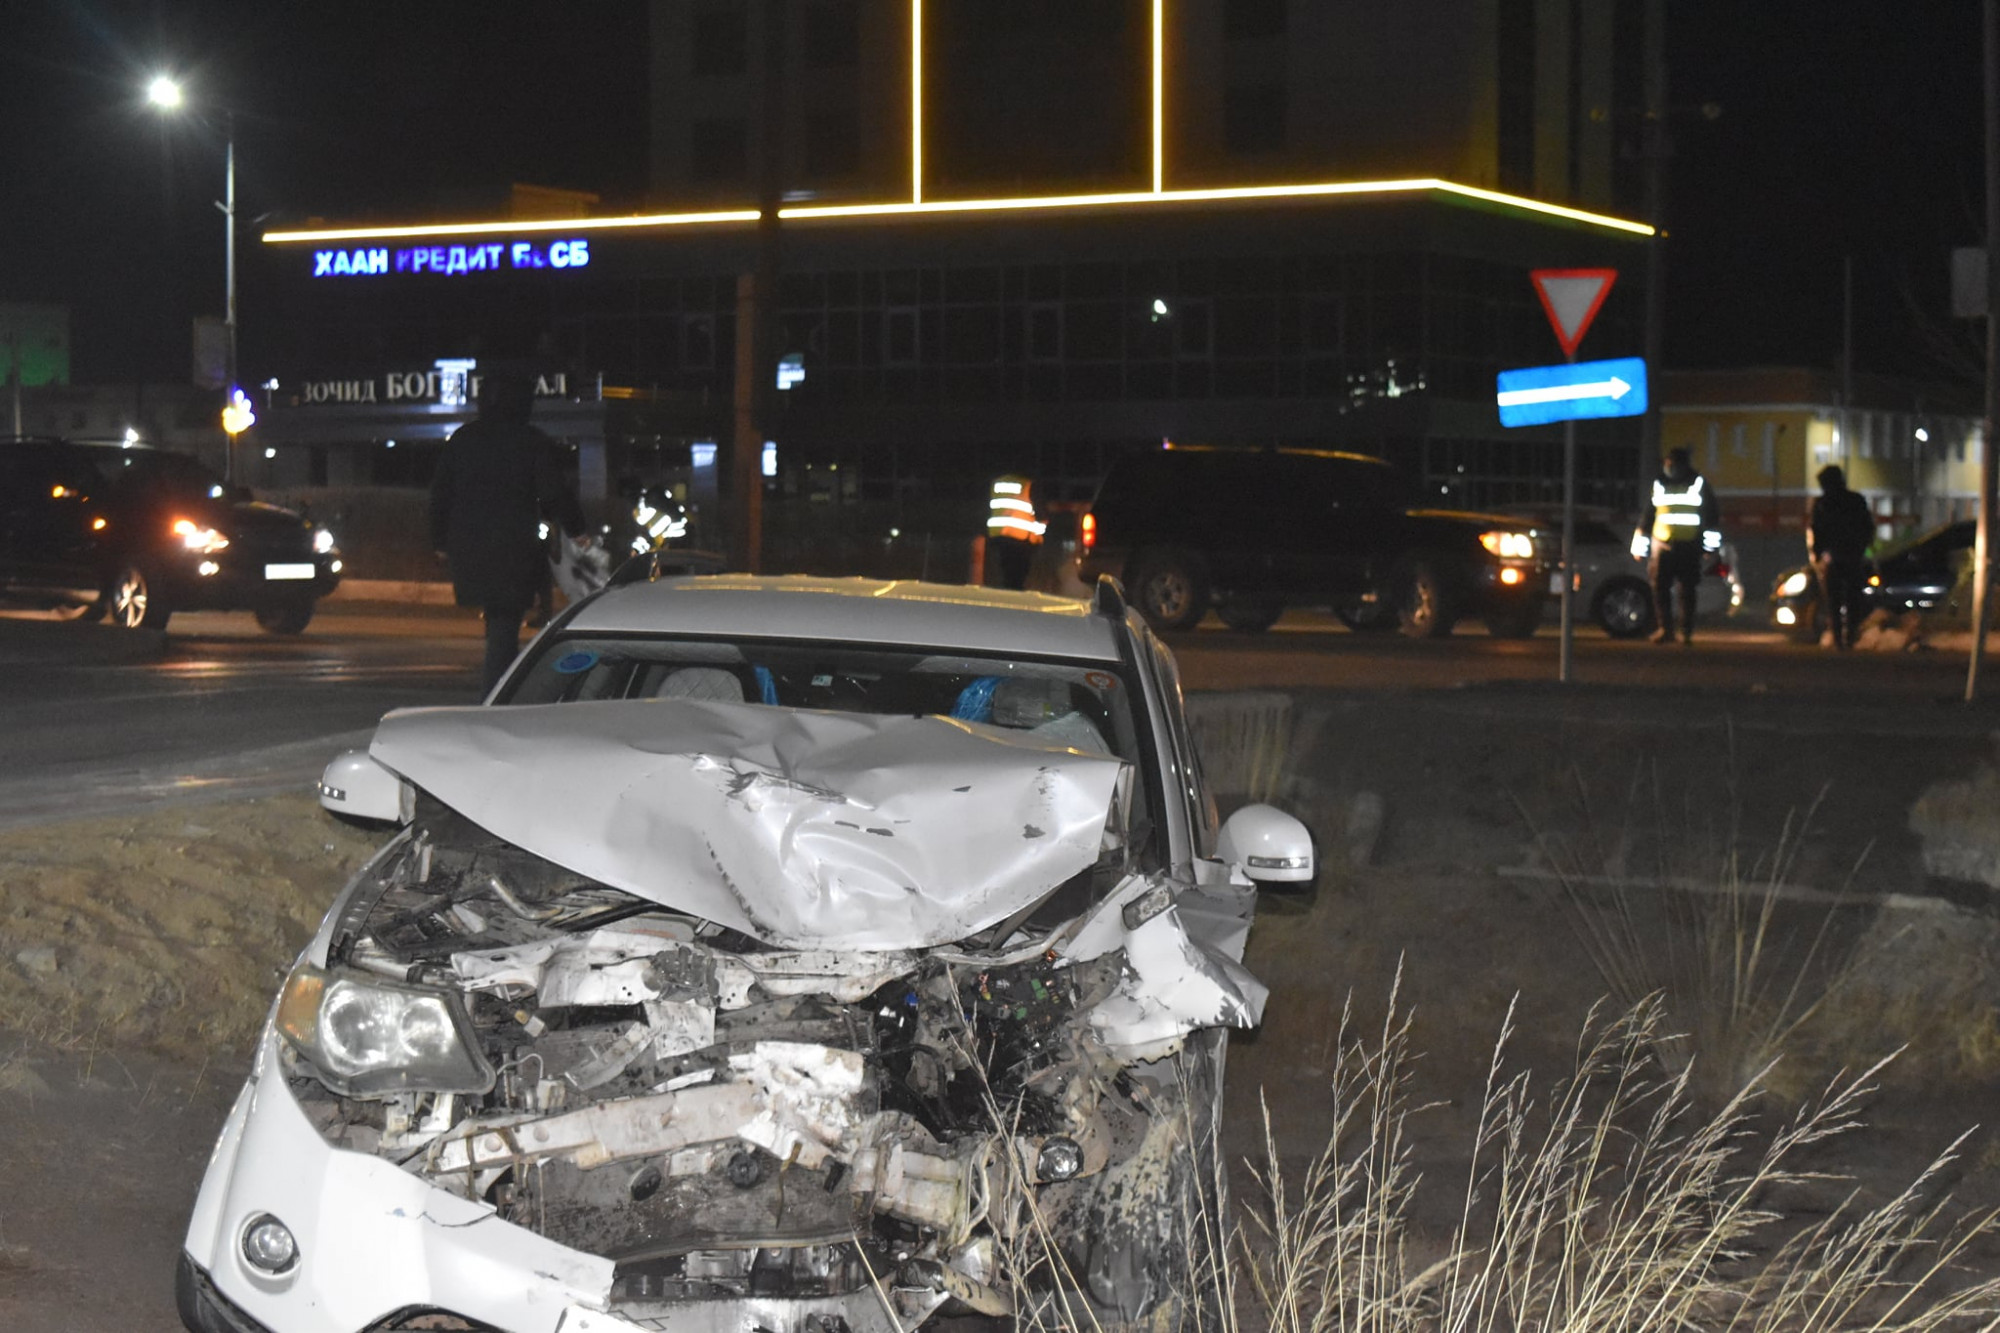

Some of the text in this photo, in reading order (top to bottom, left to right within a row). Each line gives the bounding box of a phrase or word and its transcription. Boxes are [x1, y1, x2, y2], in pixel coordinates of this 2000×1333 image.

[314, 247, 389, 277] ХААН
[396, 243, 504, 276] КРЕДИТ
[303, 378, 377, 403] ЗОЧИД
[387, 371, 467, 399] БОГ
